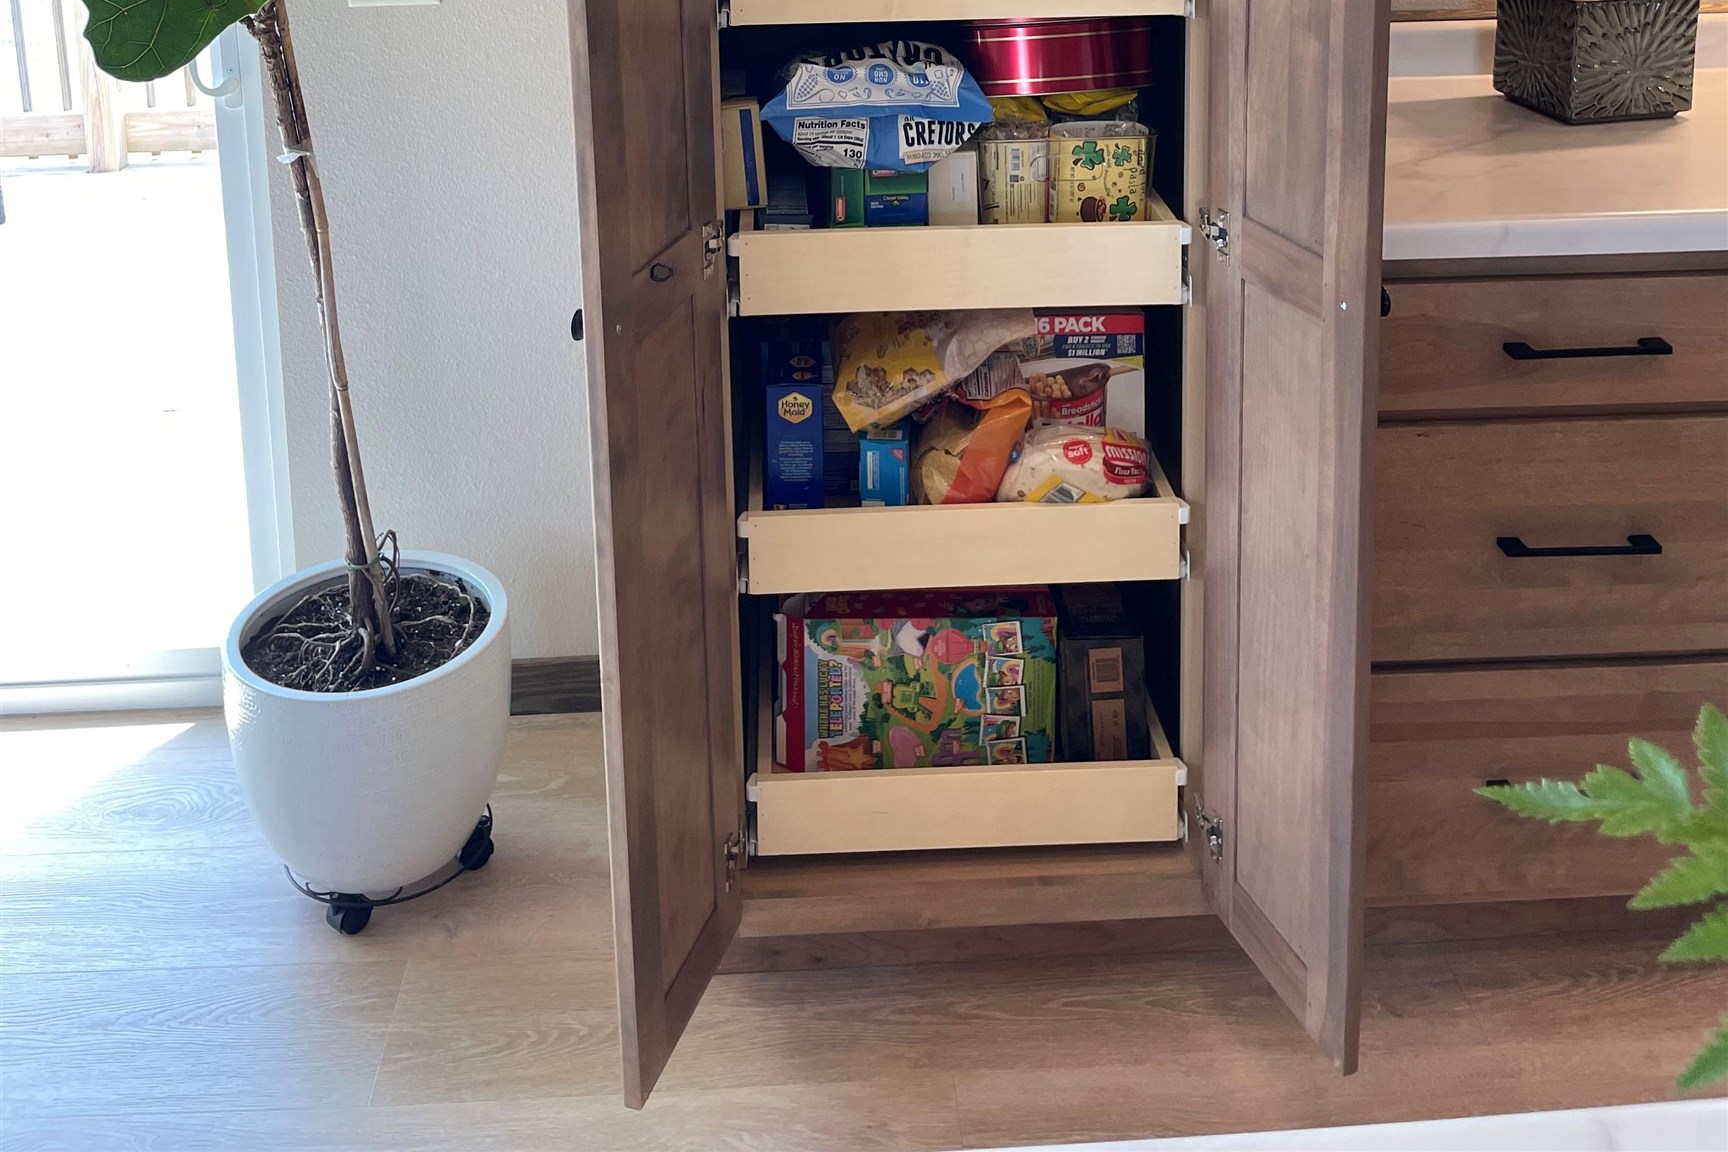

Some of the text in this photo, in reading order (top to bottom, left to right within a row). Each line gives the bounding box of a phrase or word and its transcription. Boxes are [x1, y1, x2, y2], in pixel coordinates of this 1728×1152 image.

[798, 120, 866, 129] Nutrition Facts
[843, 148, 863, 159] 130
[1123, 168, 1138, 194] pasta
[1054, 316, 1106, 333] PACK
[1067, 336, 1083, 344] BUY
[781, 400, 810, 410] Honey
[783, 408, 805, 416] Maid
[1068, 447, 1089, 458] soft
[818, 659, 829, 738] WHERE HAS LUCKY
[829, 660, 843, 738] TELEPORTED?
